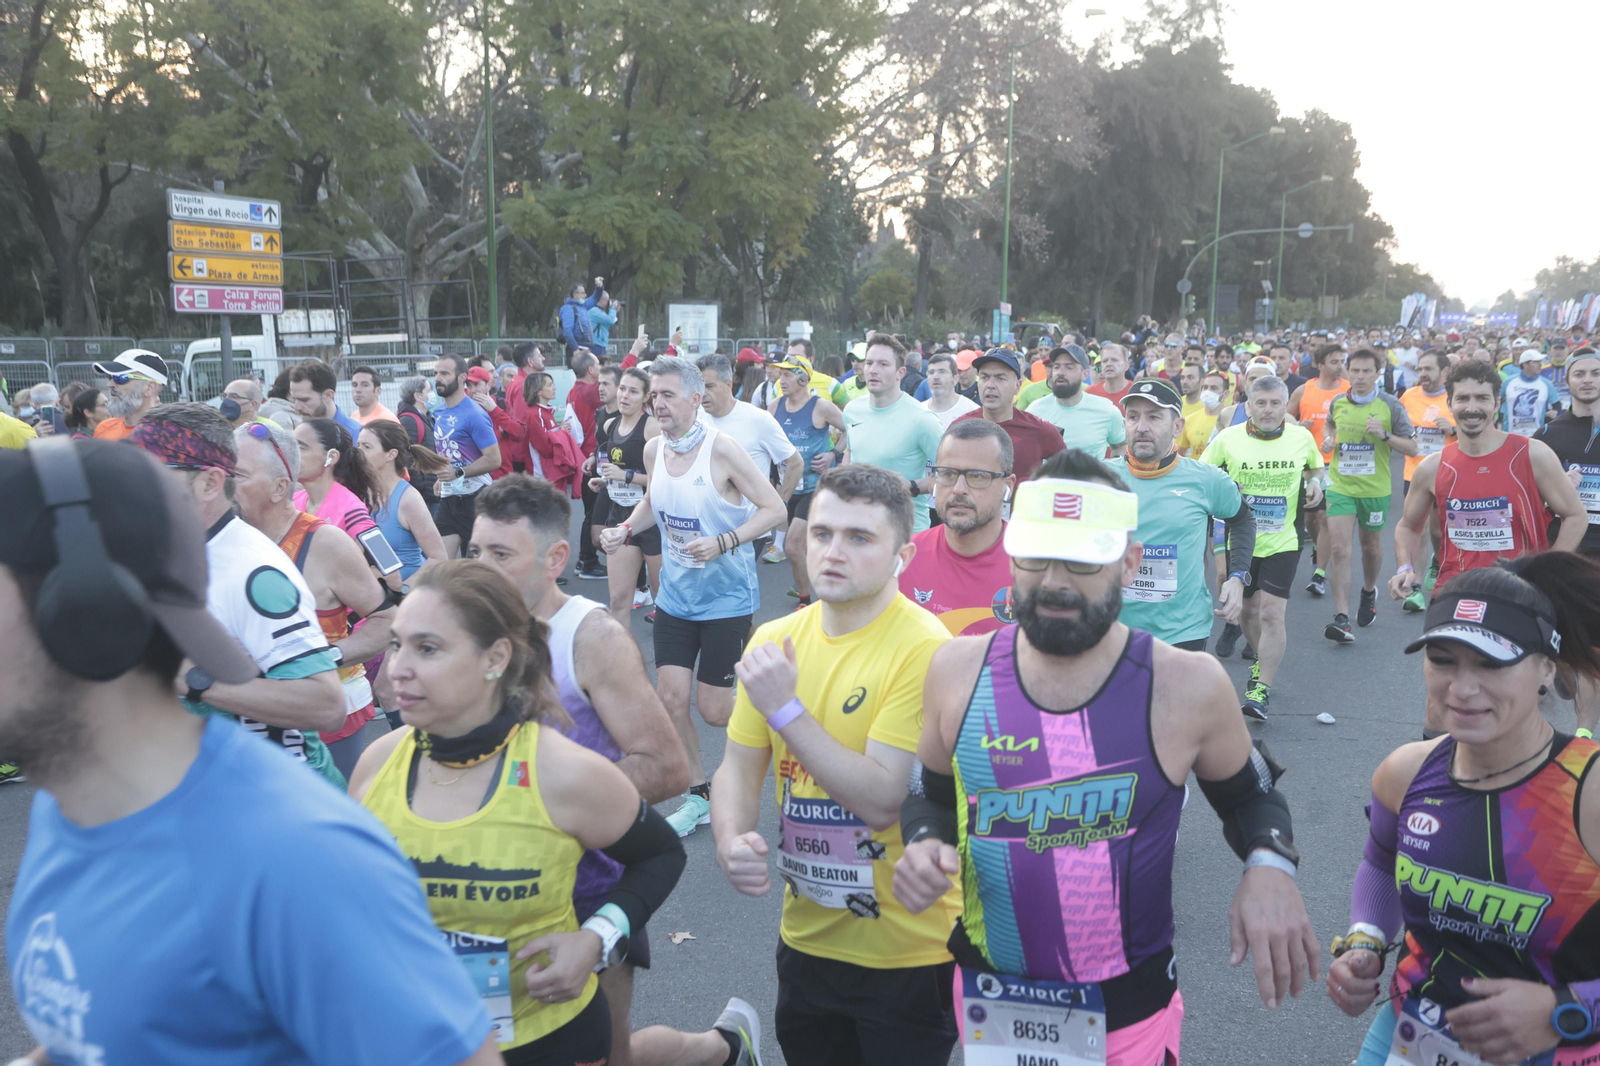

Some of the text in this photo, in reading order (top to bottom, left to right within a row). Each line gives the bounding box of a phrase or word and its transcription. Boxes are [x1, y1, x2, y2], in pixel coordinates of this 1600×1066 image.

[173, 194, 204, 204] hospital
[174, 204, 204, 216] Virgen
[208, 207, 222, 217] del
[210, 229, 234, 239] Prado
[176, 237, 194, 246] San
[208, 269, 279, 281] Plaza de Armas
[224, 289, 280, 300] Caixa Forum
[222, 300, 280, 310] Torre Sevilla
[1241, 460, 1295, 470] A. SERRA
[1580, 492, 1596, 500] COKE
[1462, 500, 1500, 510] ZURICH
[668, 518, 694, 528] ZURICH
[1465, 518, 1488, 526] 7522
[1454, 530, 1505, 538] ASICS SEVILLA
[1142, 548, 1170, 556] URICH
[1138, 566, 1153, 575] 451
[992, 755, 1024, 766] VEYSER
[790, 803, 854, 820] ZURICH
[1410, 815, 1433, 833] KIA
[795, 836, 830, 855] 6560
[1402, 834, 1430, 851] VEYSER
[782, 856, 858, 882] DAVID BEATON
[426, 880, 540, 901] EM ÉVORA
[1006, 984, 1086, 1004] ZURICH
[1013, 1020, 1060, 1043] 8635
